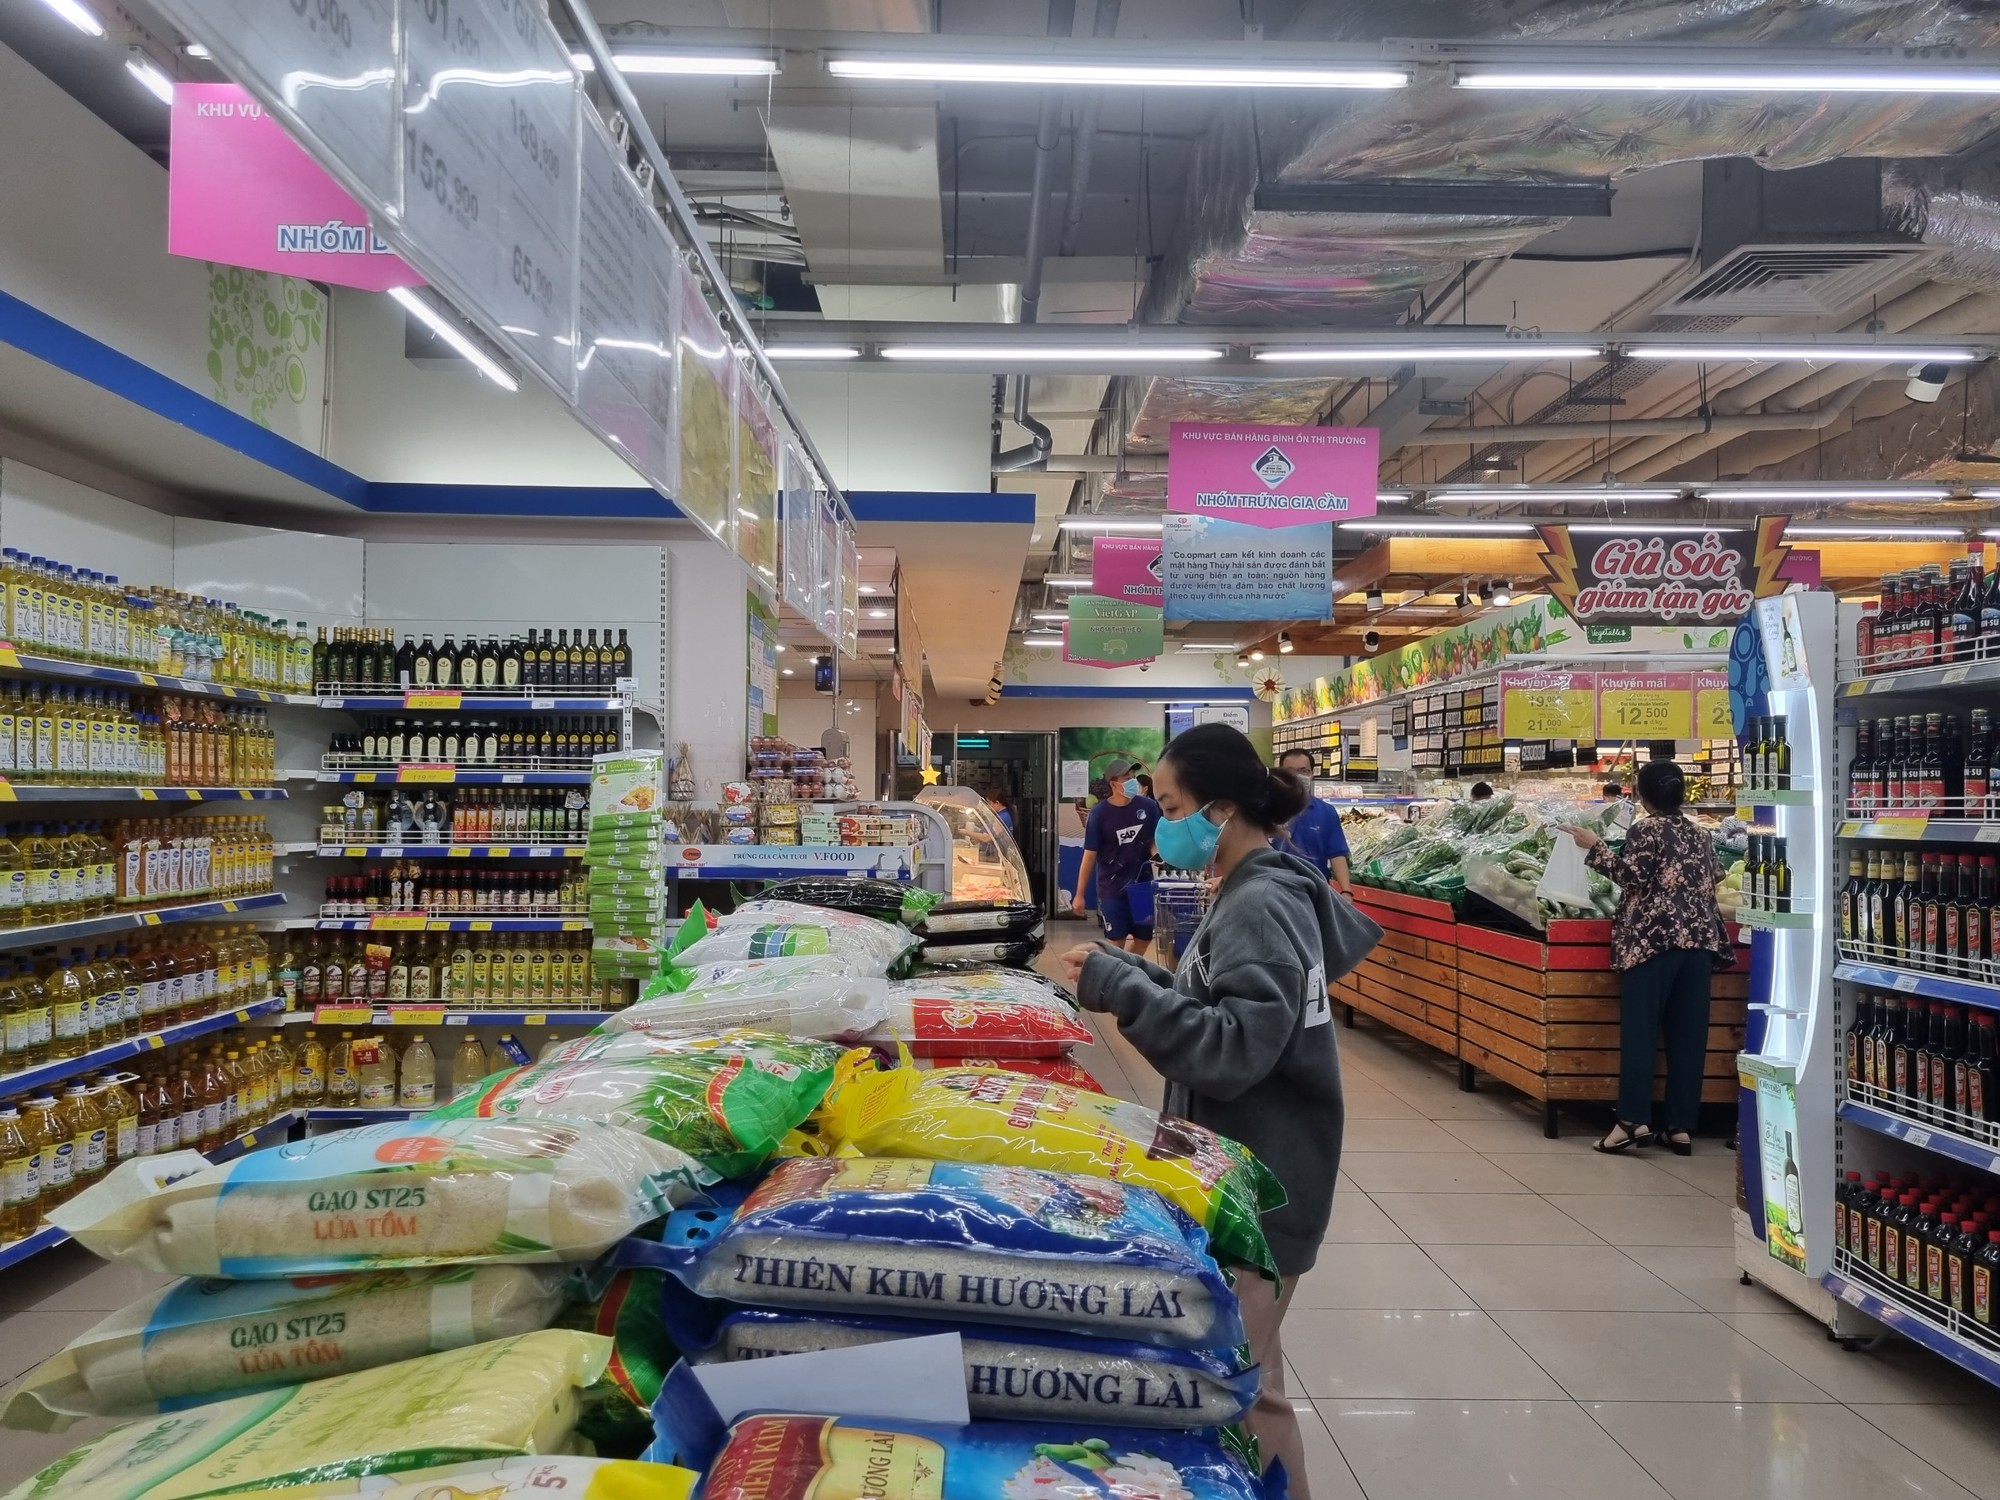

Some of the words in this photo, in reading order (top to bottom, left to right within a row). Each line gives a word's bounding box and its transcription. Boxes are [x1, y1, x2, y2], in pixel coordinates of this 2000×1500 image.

[197, 103, 234, 117] KHU
[238, 103, 270, 121] VỤ
[279, 221, 364, 252] NHÓM
[1182, 431, 1201, 440] KHU
[1203, 431, 1223, 443] VỰC
[1224, 431, 1244, 441] BÁN
[1244, 433, 1271, 443] HÀNG
[1272, 432, 1294, 443] BÌNH
[1311, 434, 1326, 446] THỊ
[1327, 434, 1366, 445] TRƯỜNG
[1196, 490, 1239, 508] NHÓM
[1239, 490, 1288, 509] TRỨNG
[1290, 496, 1317, 511] GIA
[1318, 491, 1348, 511] CẦM
[1242, 551, 1254, 559] kết
[1258, 551, 1277, 559] kinh
[1280, 551, 1307, 559] doanh
[1310, 551, 1325, 559] các
[1592, 538, 1663, 577] Giá
[1665, 532, 1739, 579] Sốc
[1169, 561, 1186, 571] mặt
[1187, 561, 1208, 571] hàng
[1263, 561, 1287, 571] được
[1289, 561, 1310, 569] đánh
[1184, 572, 1205, 581] vùng
[1273, 571, 1300, 581] nguồn
[1304, 571, 1326, 581] hàng
[1123, 584, 1151, 596] NHÓM
[1169, 582, 1193, 591] được
[1220, 582, 1232, 590] tra
[1277, 581, 1296, 590] chất
[1299, 581, 1325, 591] lượng
[1170, 592, 1188, 600] theo
[1577, 581, 1651, 615] giảm
[1652, 583, 1699, 617] tận
[1700, 581, 1751, 615] gốc
[1094, 608, 1138, 618] VietGAP
[1505, 677, 1547, 689] Khuyến
[1601, 677, 1644, 690] Khuyến
[1646, 677, 1667, 688] mãi
[1527, 719, 1562, 732] 21.000
[1616, 707, 1669, 726] 12.500
[1119, 829, 1136, 842] SAP
[733, 852, 757, 860] TRỨNG
[814, 851, 855, 861] V.FOOD
[308, 1190, 358, 1213] GẠO
[364, 1187, 426, 1210] ST25
[365, 1209, 420, 1238] TÔM
[734, 1254, 857, 1293] THIÊN
[866, 1266, 947, 1301] KIM
[957, 1274, 1109, 1316] HƯƠNG
[1119, 1281, 1186, 1319] LÀI
[230, 1321, 279, 1348] GẠO
[286, 1311, 347, 1340] ST25
[289, 1338, 343, 1367] TÔM
[969, 1364, 1123, 1405] HƯƠNG
[1134, 1373, 1203, 1409] LÀI
[865, 1431, 896, 1455] LÀI
[861, 1455, 893, 1500] ƯƠNG
